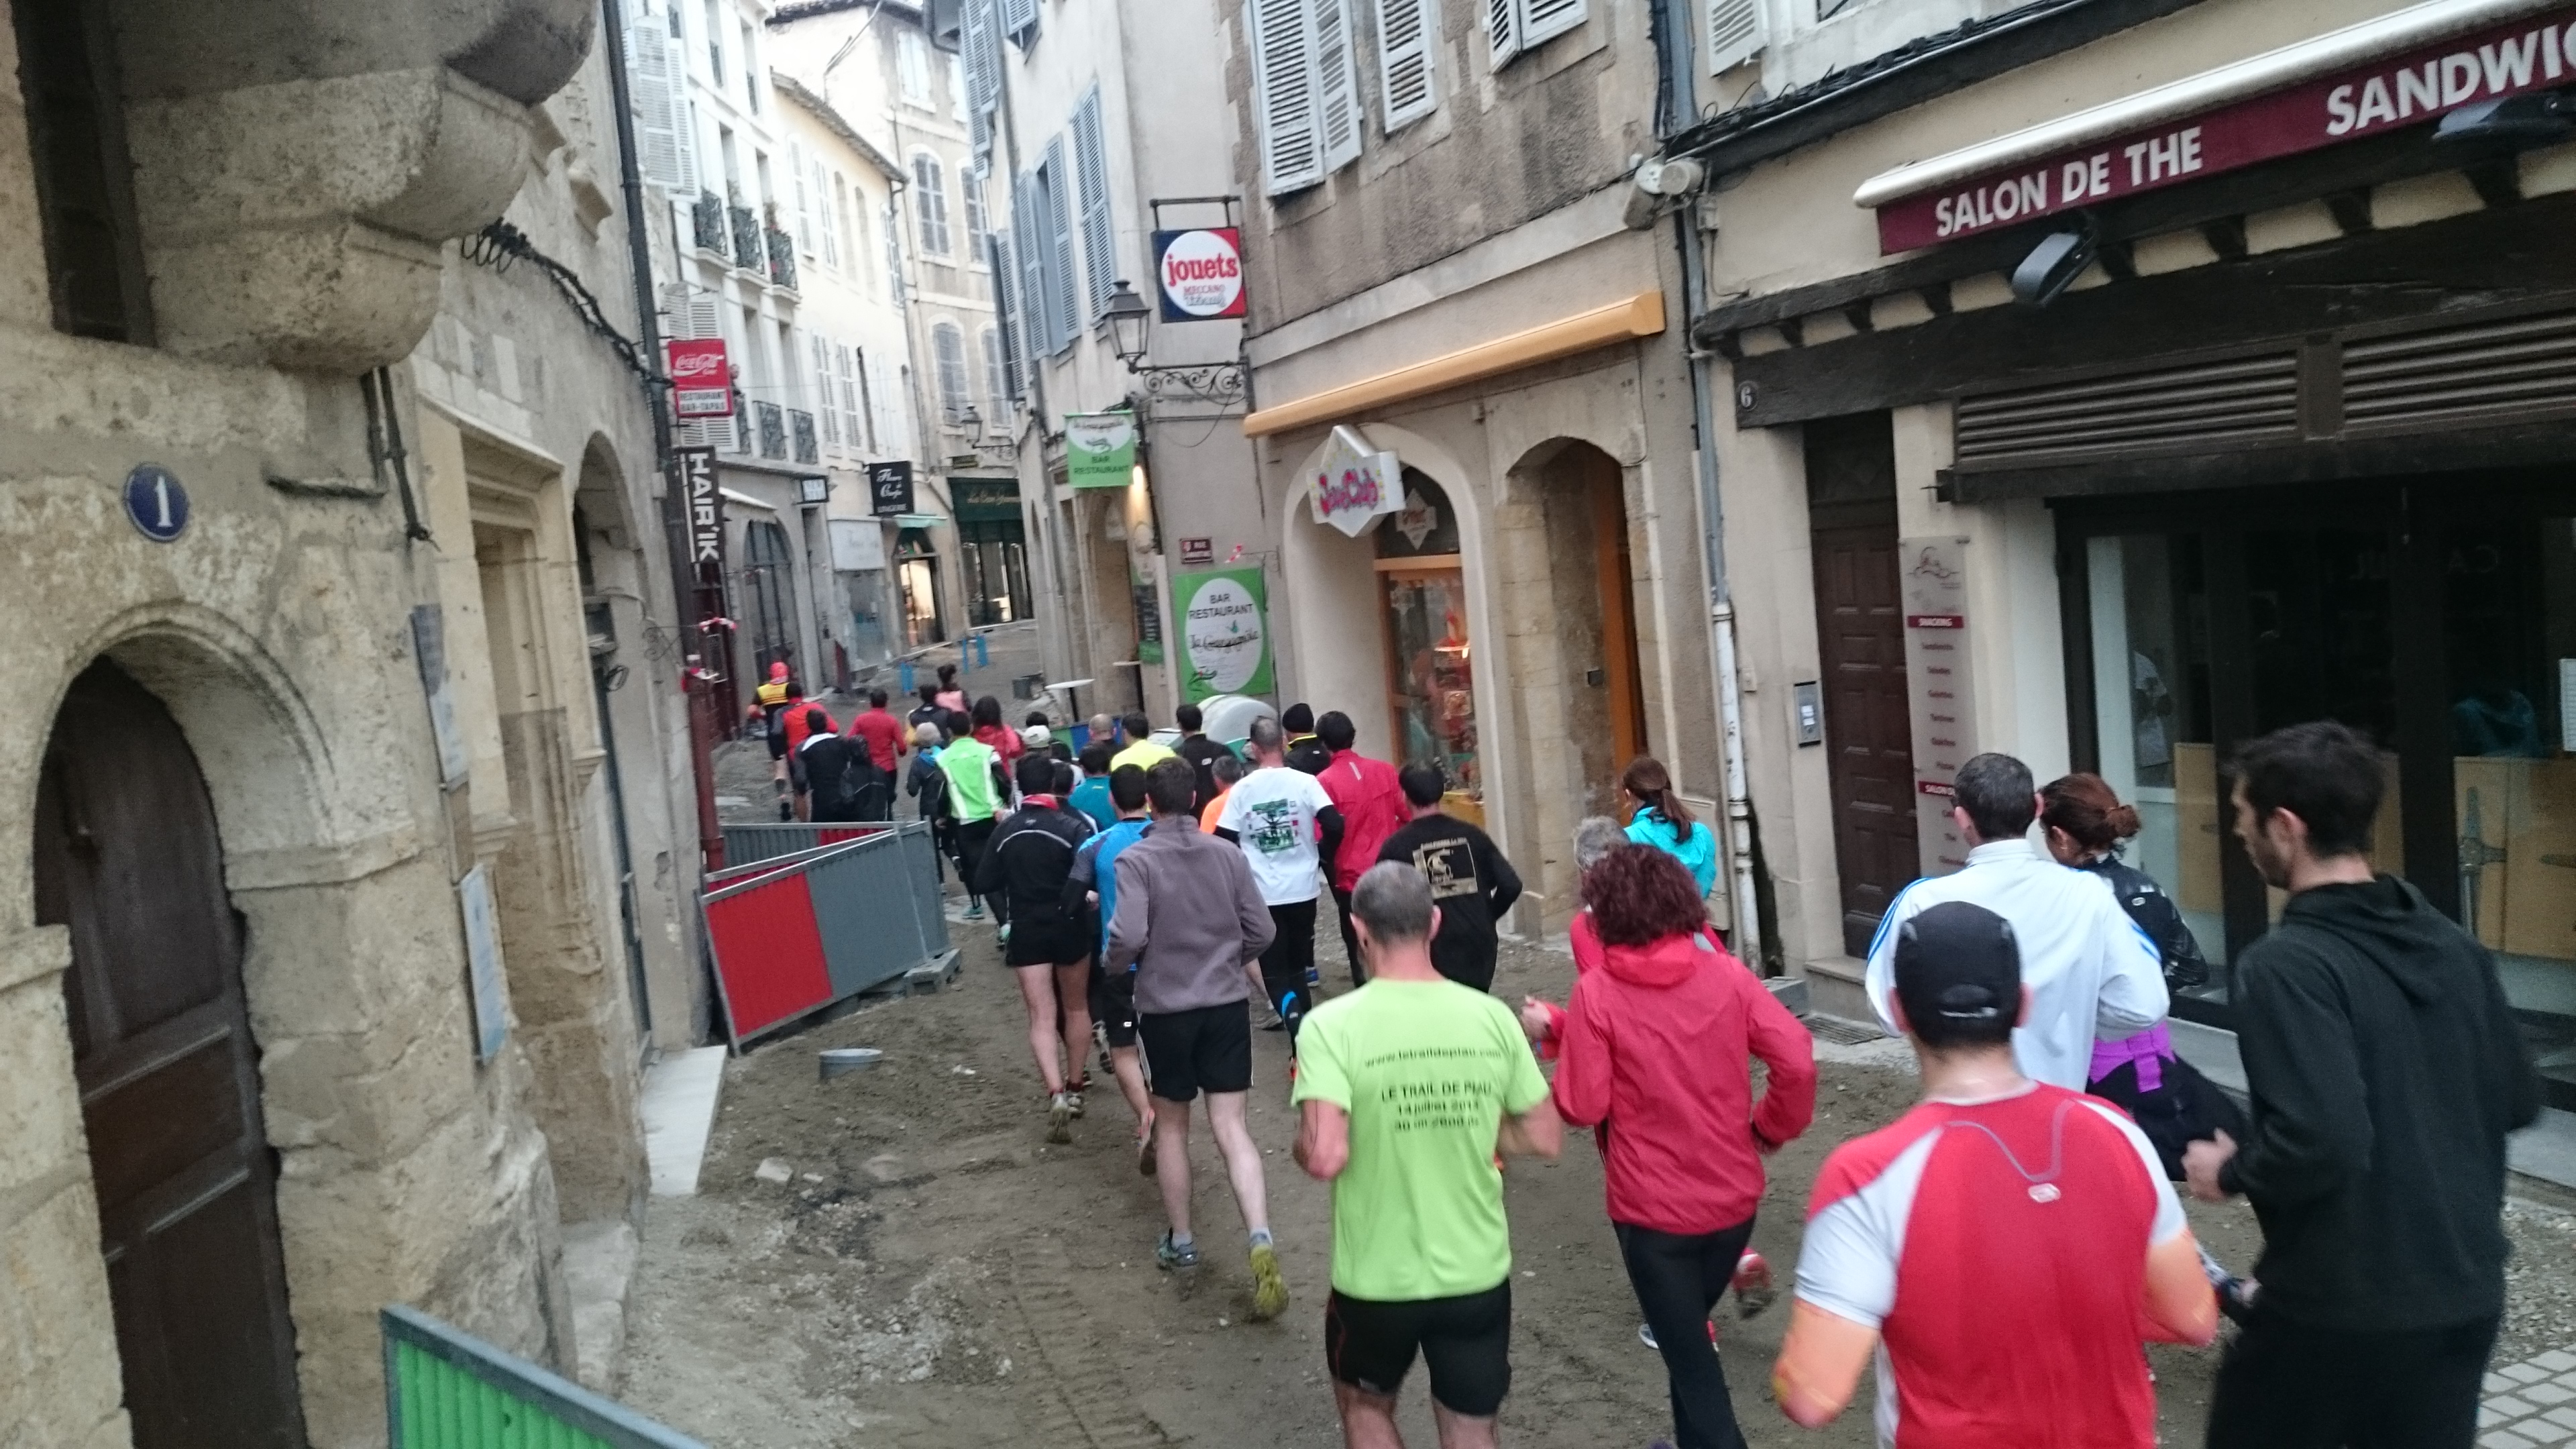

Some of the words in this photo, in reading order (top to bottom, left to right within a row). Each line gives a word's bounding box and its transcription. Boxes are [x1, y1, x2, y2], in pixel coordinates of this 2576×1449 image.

[1935, 170, 2048, 237] SALON
[2061, 153, 2110, 204] DE
[2124, 125, 2203, 187] THE
[1167, 252, 1238, 286] jouets
[1740, 386, 1752, 408] 6
[1073, 465, 1130, 475] RESTAURANT
[1091, 455, 1110, 464] BAR
[154, 474, 174, 527] 1
[1210, 593, 1231, 604] BAR
[1188, 603, 1253, 620] RESTAURANT
[1382, 1085, 1397, 1102] LE
[1400, 1081, 1439, 1099] TRAIL
[1442, 1081, 1460, 1097] DE
